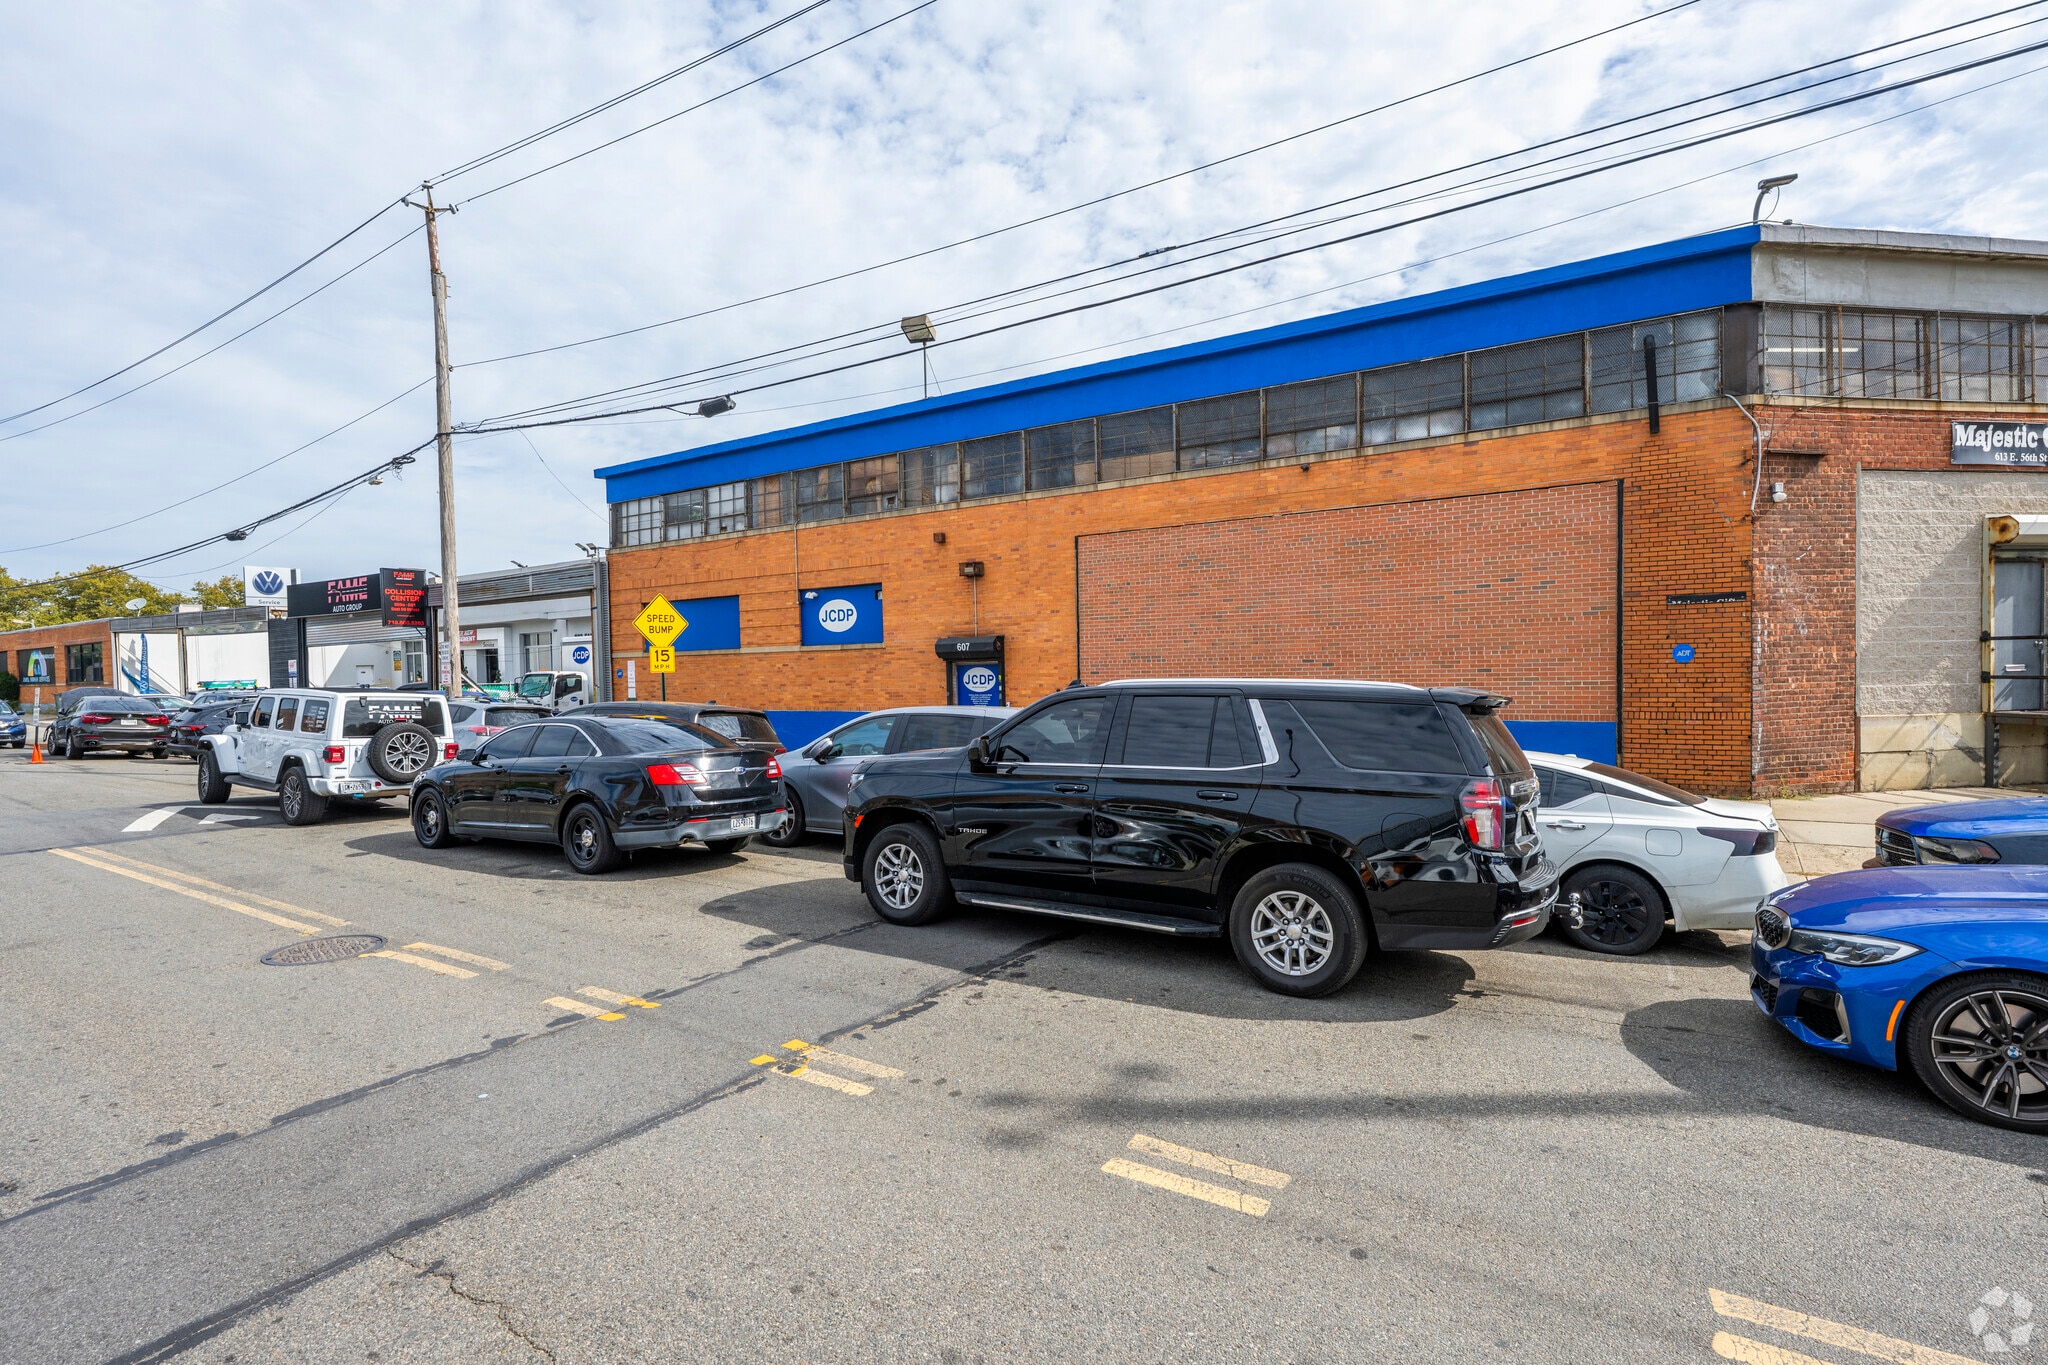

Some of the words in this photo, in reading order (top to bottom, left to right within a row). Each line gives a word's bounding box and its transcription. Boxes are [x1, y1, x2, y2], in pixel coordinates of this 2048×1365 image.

[1955, 424, 2039, 452] Majestic
[1995, 452, 2009, 461] 613
[2010, 453, 2018, 461] E.
[2020, 453, 2037, 462] 56th
[393, 571, 415, 579] FAME
[327, 576, 368, 604] FAME
[384, 588, 425, 596] COLLISION
[332, 605, 346, 613] AUTO
[346, 602, 363, 611] GROUP
[646, 614, 676, 623] SPEED
[821, 608, 854, 623] JCDP
[648, 625, 674, 634] BUMP
[956, 642, 970, 651] 607
[573, 650, 590, 660] JCDP
[654, 649, 670, 662] 15
[1676, 649, 1692, 657] ADT
[964, 674, 995, 685] JCDP
[368, 705, 423, 719] FAME
[957, 827, 988, 835] TAHOE
